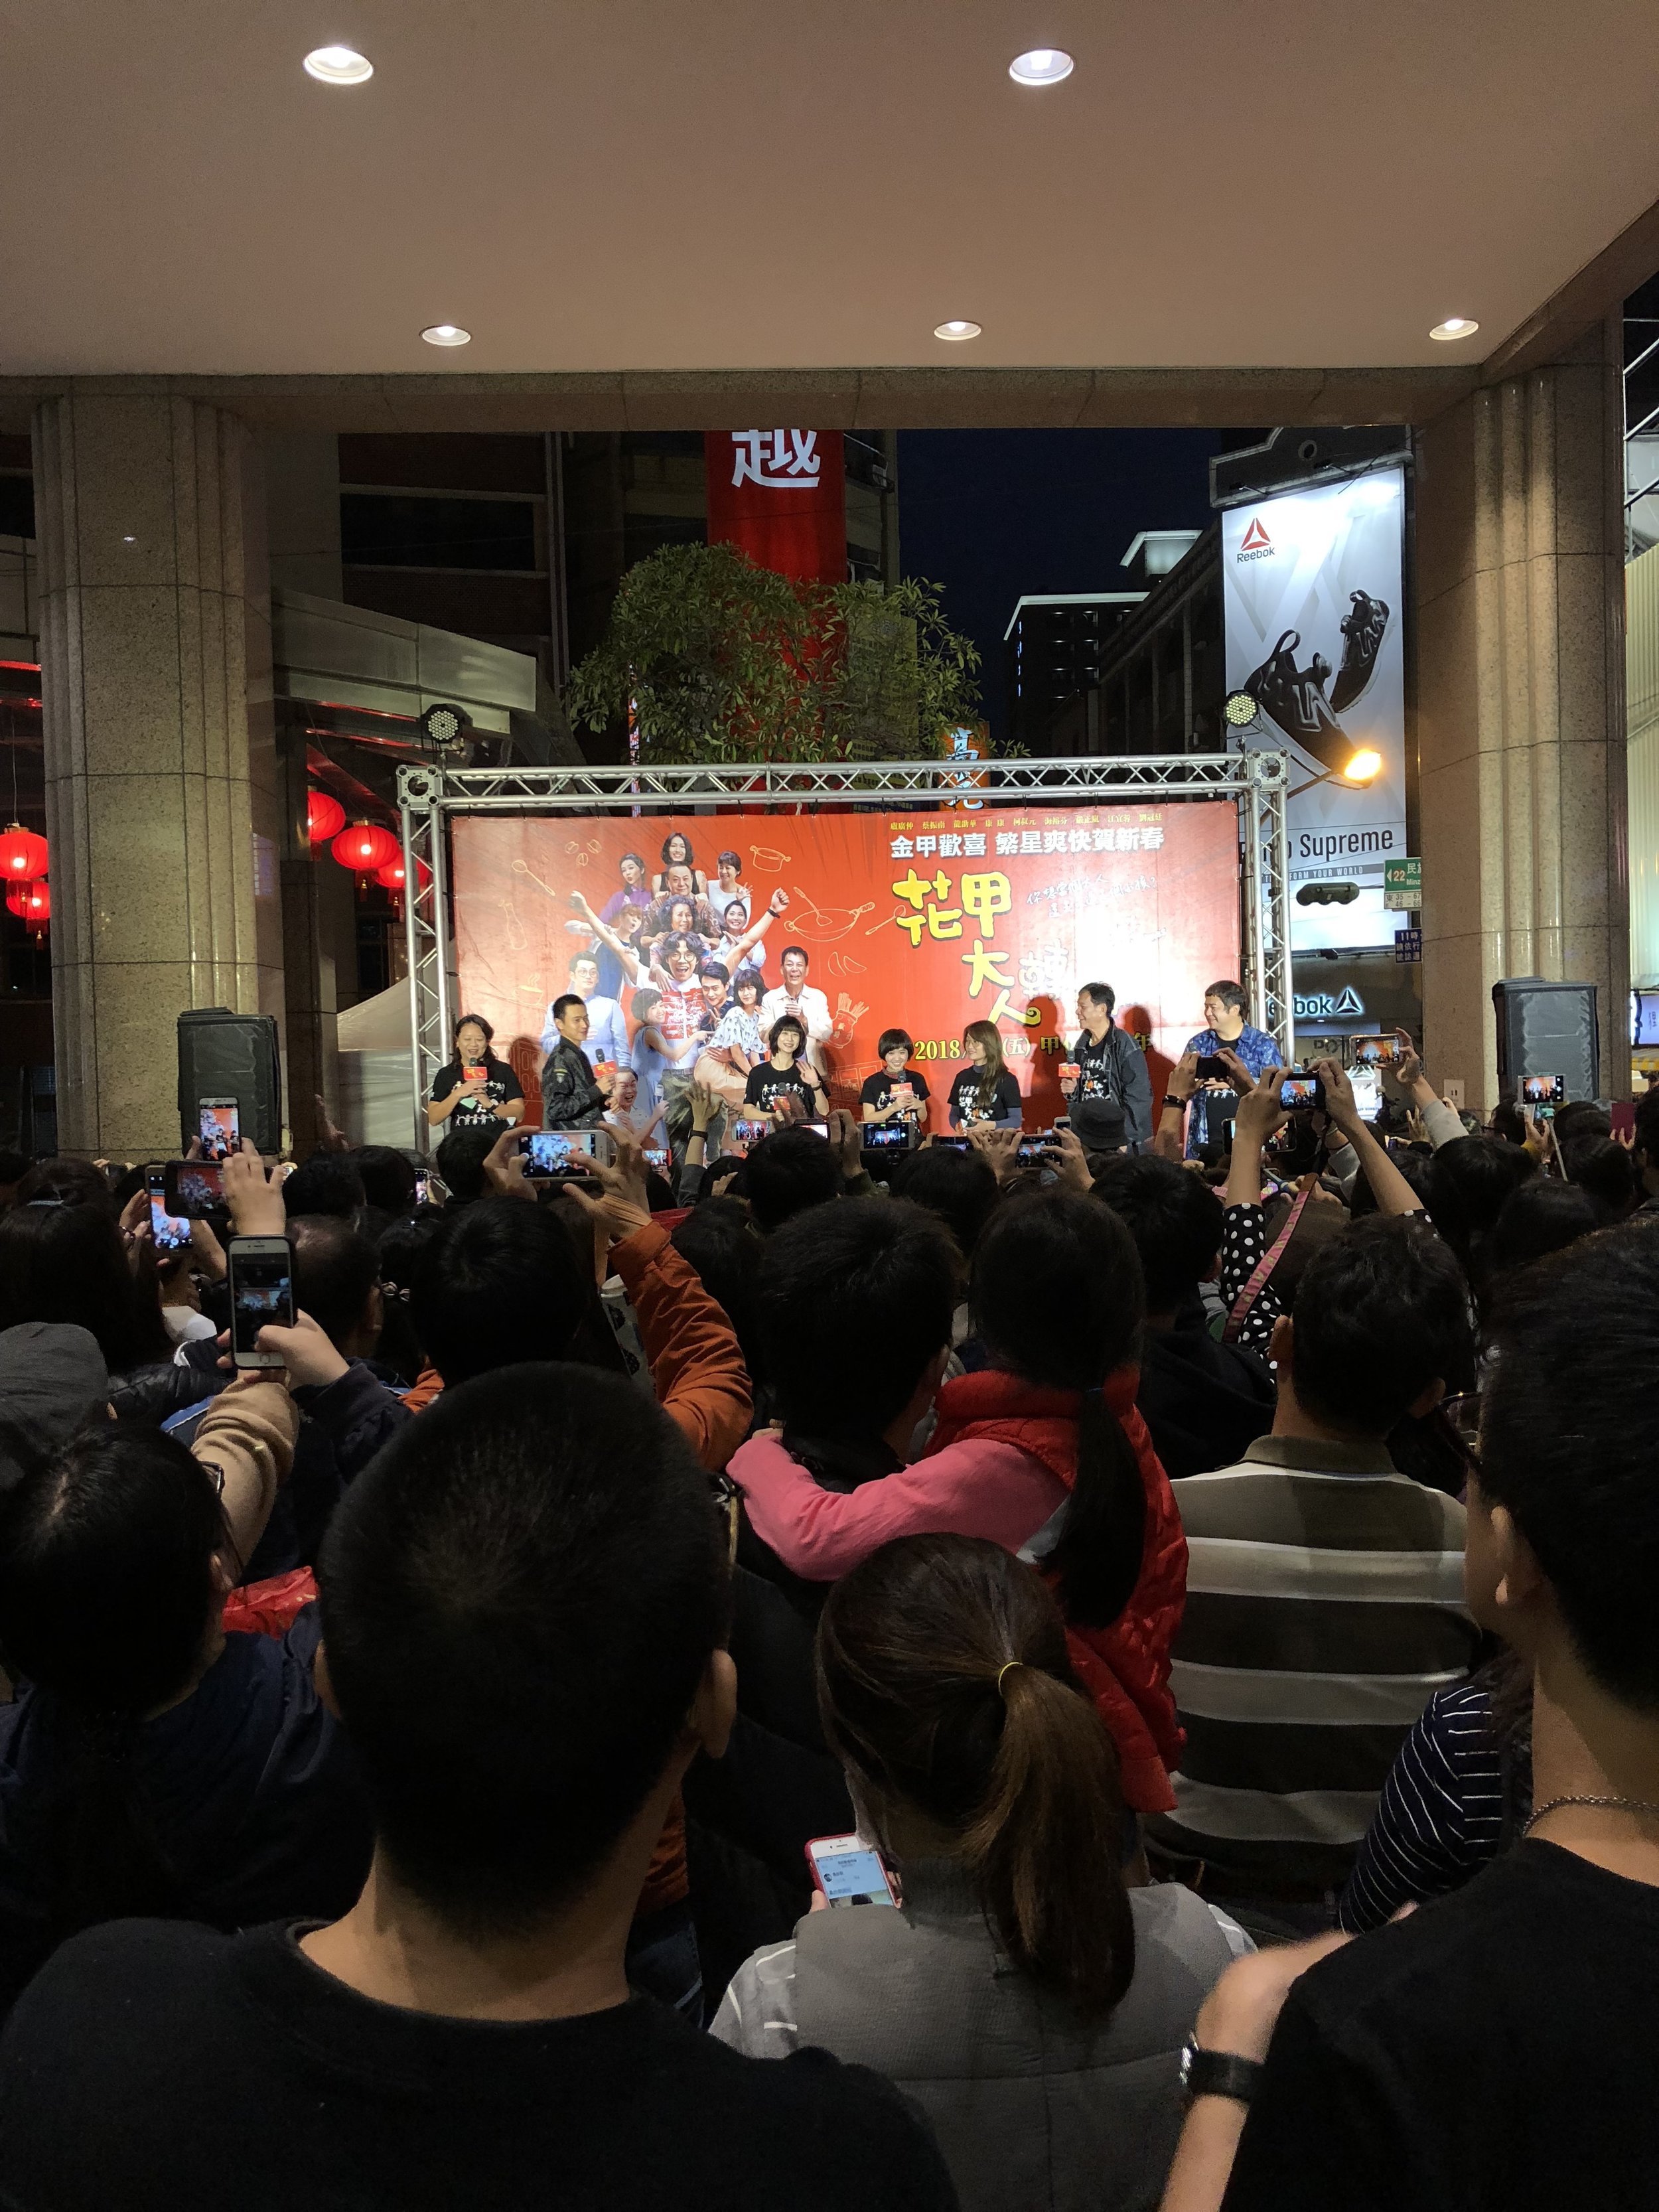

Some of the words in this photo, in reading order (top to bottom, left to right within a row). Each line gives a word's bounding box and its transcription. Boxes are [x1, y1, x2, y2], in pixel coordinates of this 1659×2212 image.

[1236, 546, 1275, 563] Reebok
[890, 832, 987, 859] 金甲歡喜
[995, 826, 1165, 856] 繁星爽快賀新春
[1299, 829, 1394, 862] Supreme
[1313, 869, 1333, 878] YOUR
[1336, 866, 1363, 876] WORLD
[1394, 870, 1406, 881] 22
[892, 869, 1012, 948] 花甲
